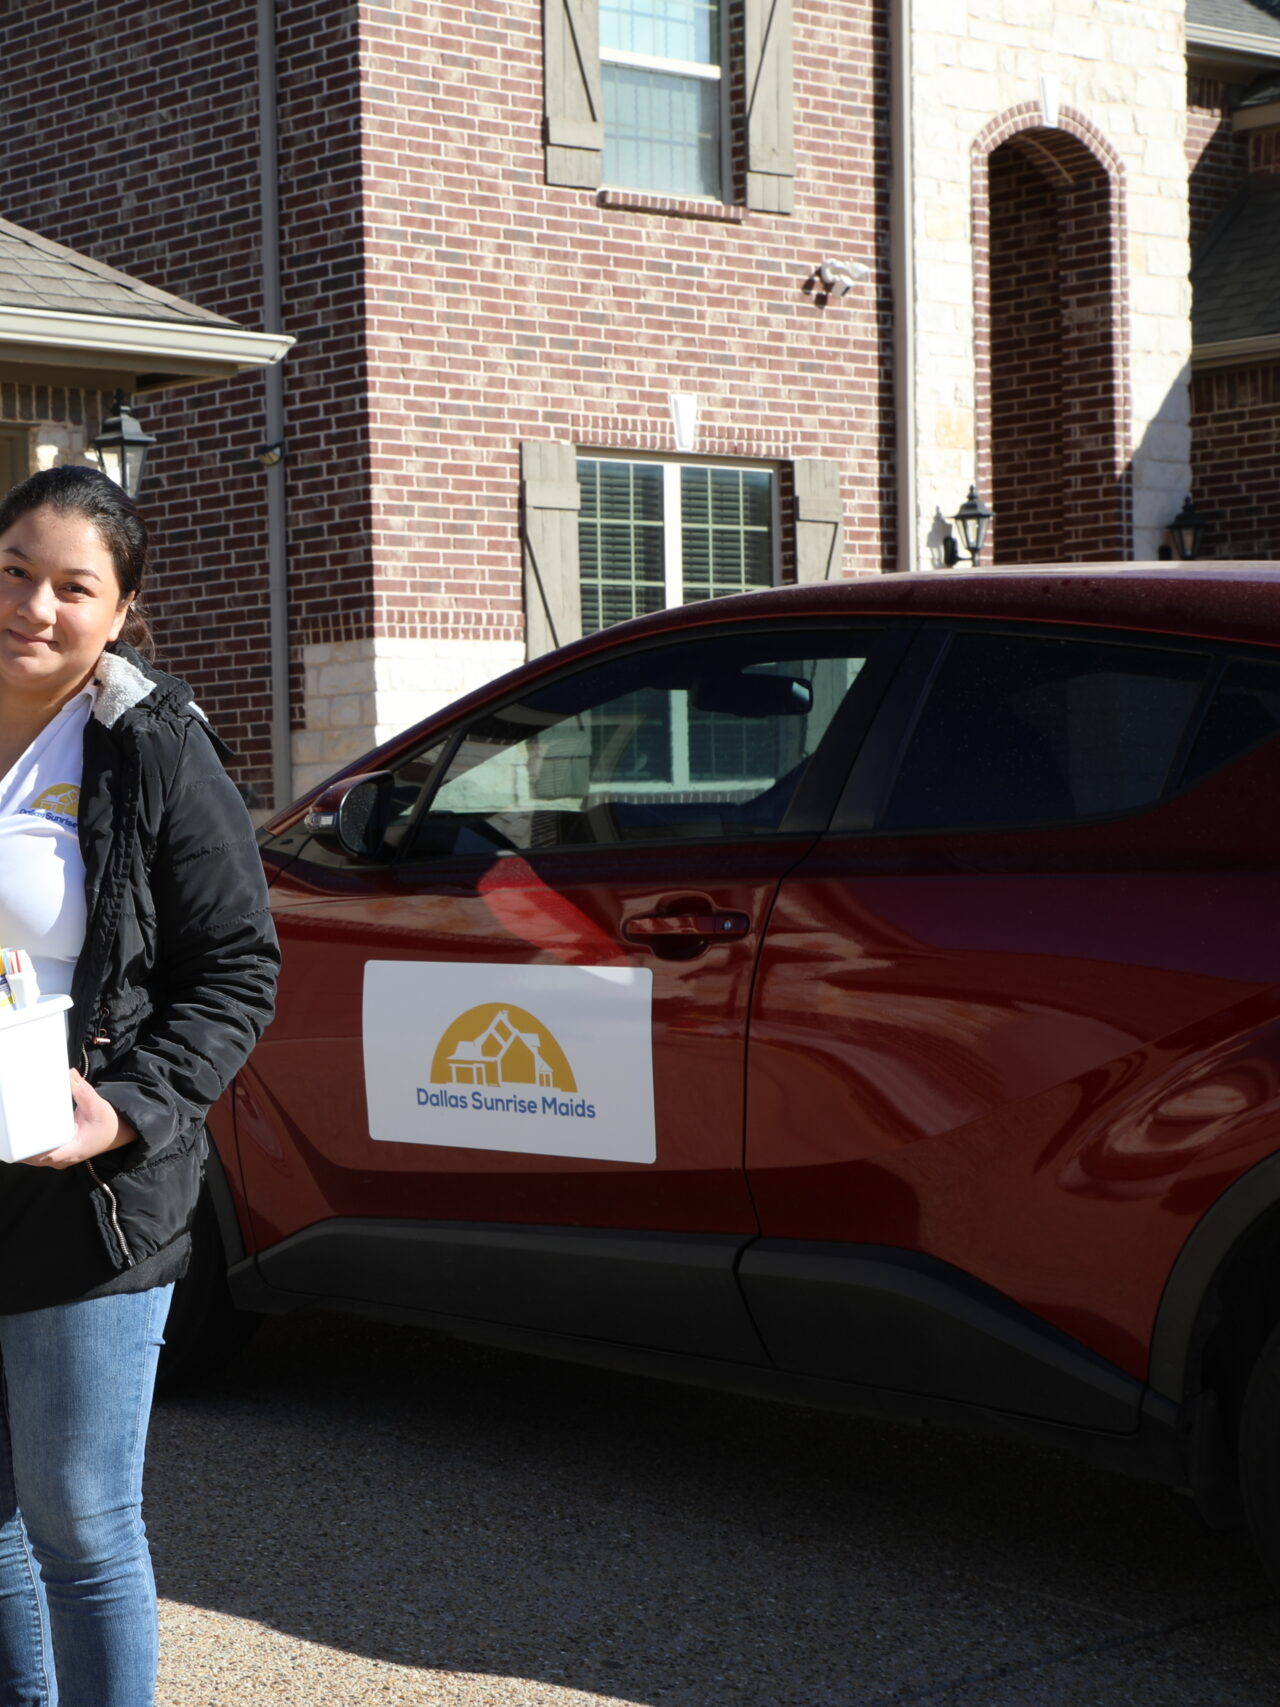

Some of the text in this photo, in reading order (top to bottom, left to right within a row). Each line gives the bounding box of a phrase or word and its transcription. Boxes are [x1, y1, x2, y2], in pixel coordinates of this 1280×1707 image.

[45, 812, 78, 828] Sunrise
[416, 1088, 597, 1118] Dallas Sunrise Maids
